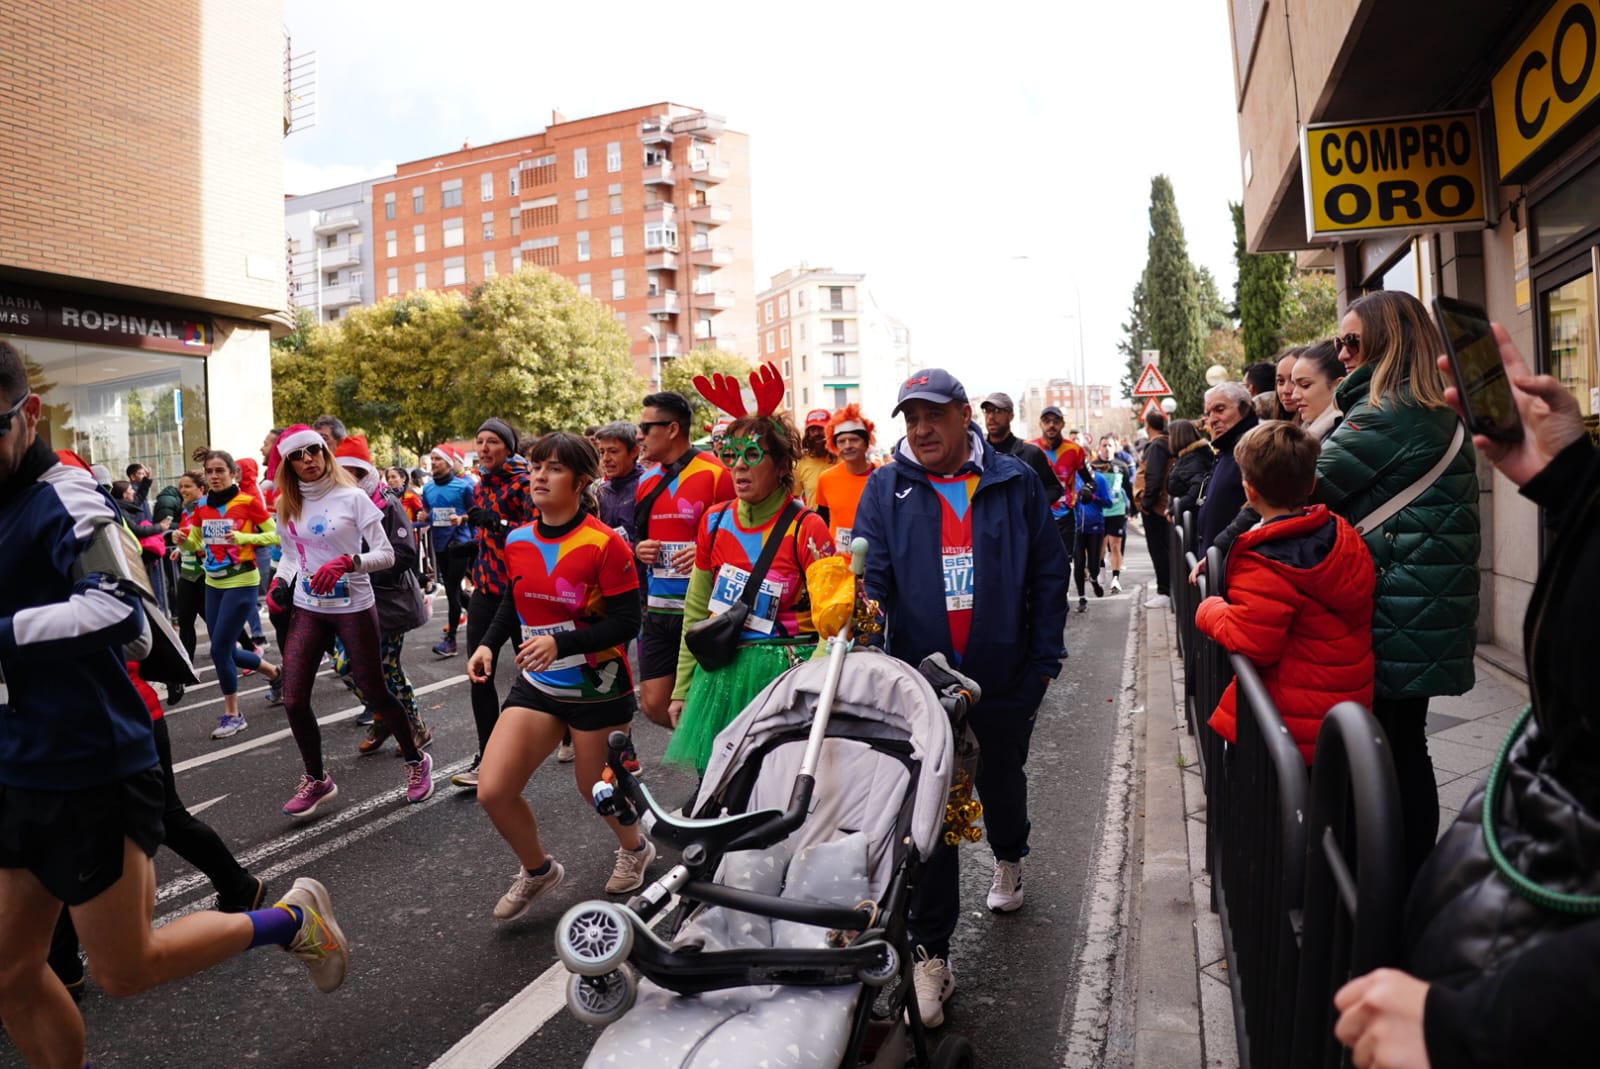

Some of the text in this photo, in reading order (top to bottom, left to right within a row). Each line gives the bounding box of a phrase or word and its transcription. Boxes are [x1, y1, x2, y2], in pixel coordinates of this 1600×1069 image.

[1514, 3, 1597, 140] CO
[1321, 121, 1471, 176] COMPRO
[1324, 175, 1475, 225] ORO
[61, 306, 179, 340] ROPINAL
[735, 572, 773, 593] SEEL
